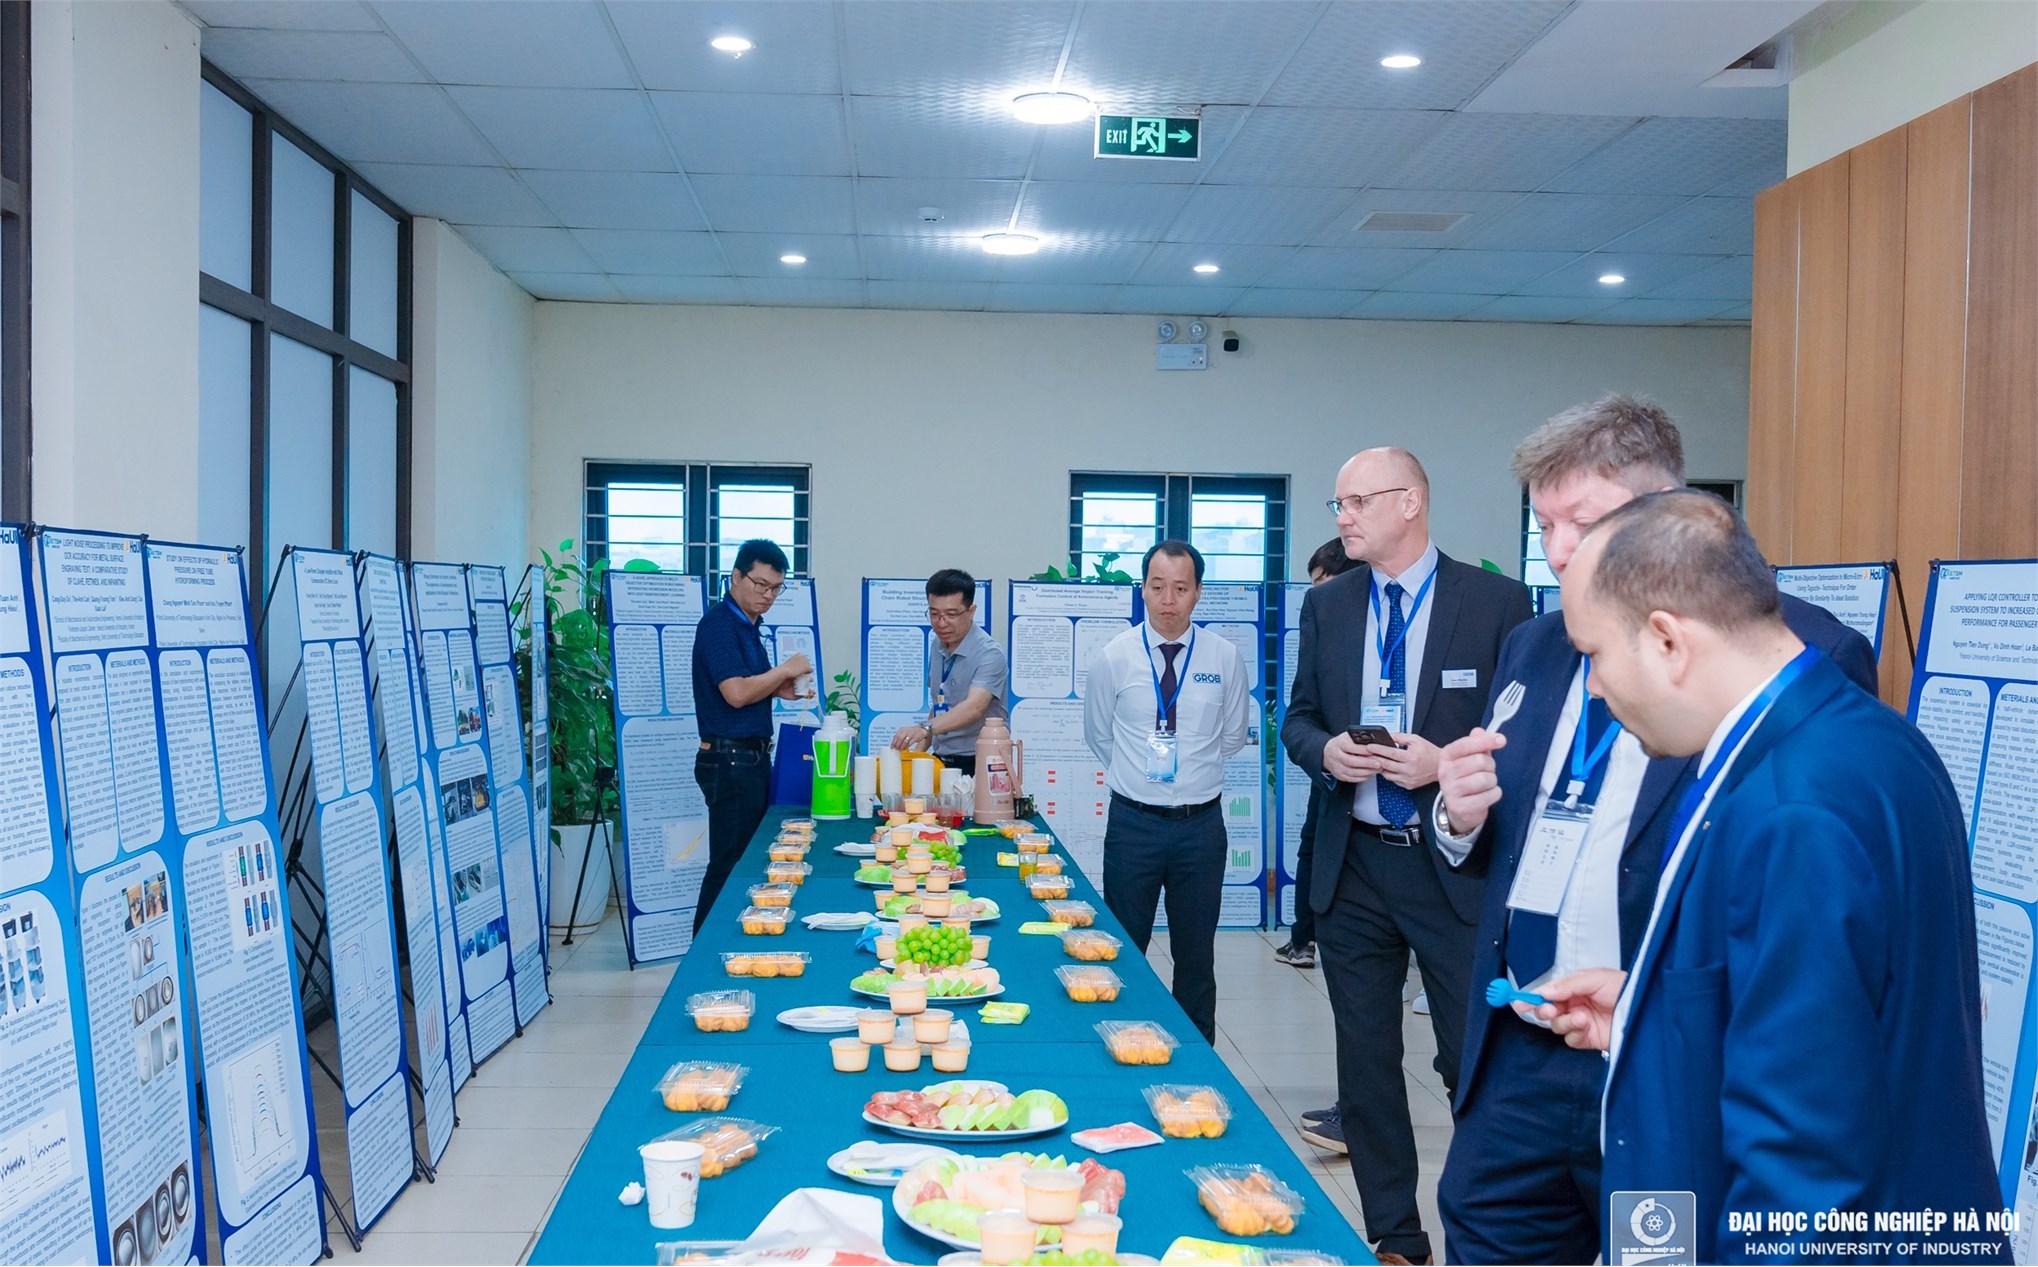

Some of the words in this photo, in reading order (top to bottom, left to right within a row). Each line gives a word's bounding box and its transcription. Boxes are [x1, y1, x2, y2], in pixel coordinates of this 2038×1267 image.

[1106, 129, 1128, 144] EXIT
[1964, 593, 1987, 601] APPLYING
[1987, 594, 1998, 602] LQR
[1998, 594, 2031, 602] CONTROLLER
[1950, 605, 1980, 613] SUSPENSION
[1980, 606, 1999, 614] SYSTEM
[1999, 606, 2006, 614] TO
[2007, 607, 2036, 615] INCREASED
[1961, 618, 1997, 627] PERFORMANCE
[1997, 619, 2008, 627] FOR
[2008, 619, 2037, 629] PASSENGER
[68, 663, 92, 672] INTRODUCTION
[1193, 673, 1221, 684] GROB
[1939, 687, 1973, 697] INTRODUCTION
[1973, 898, 1995, 910] CUSSION
